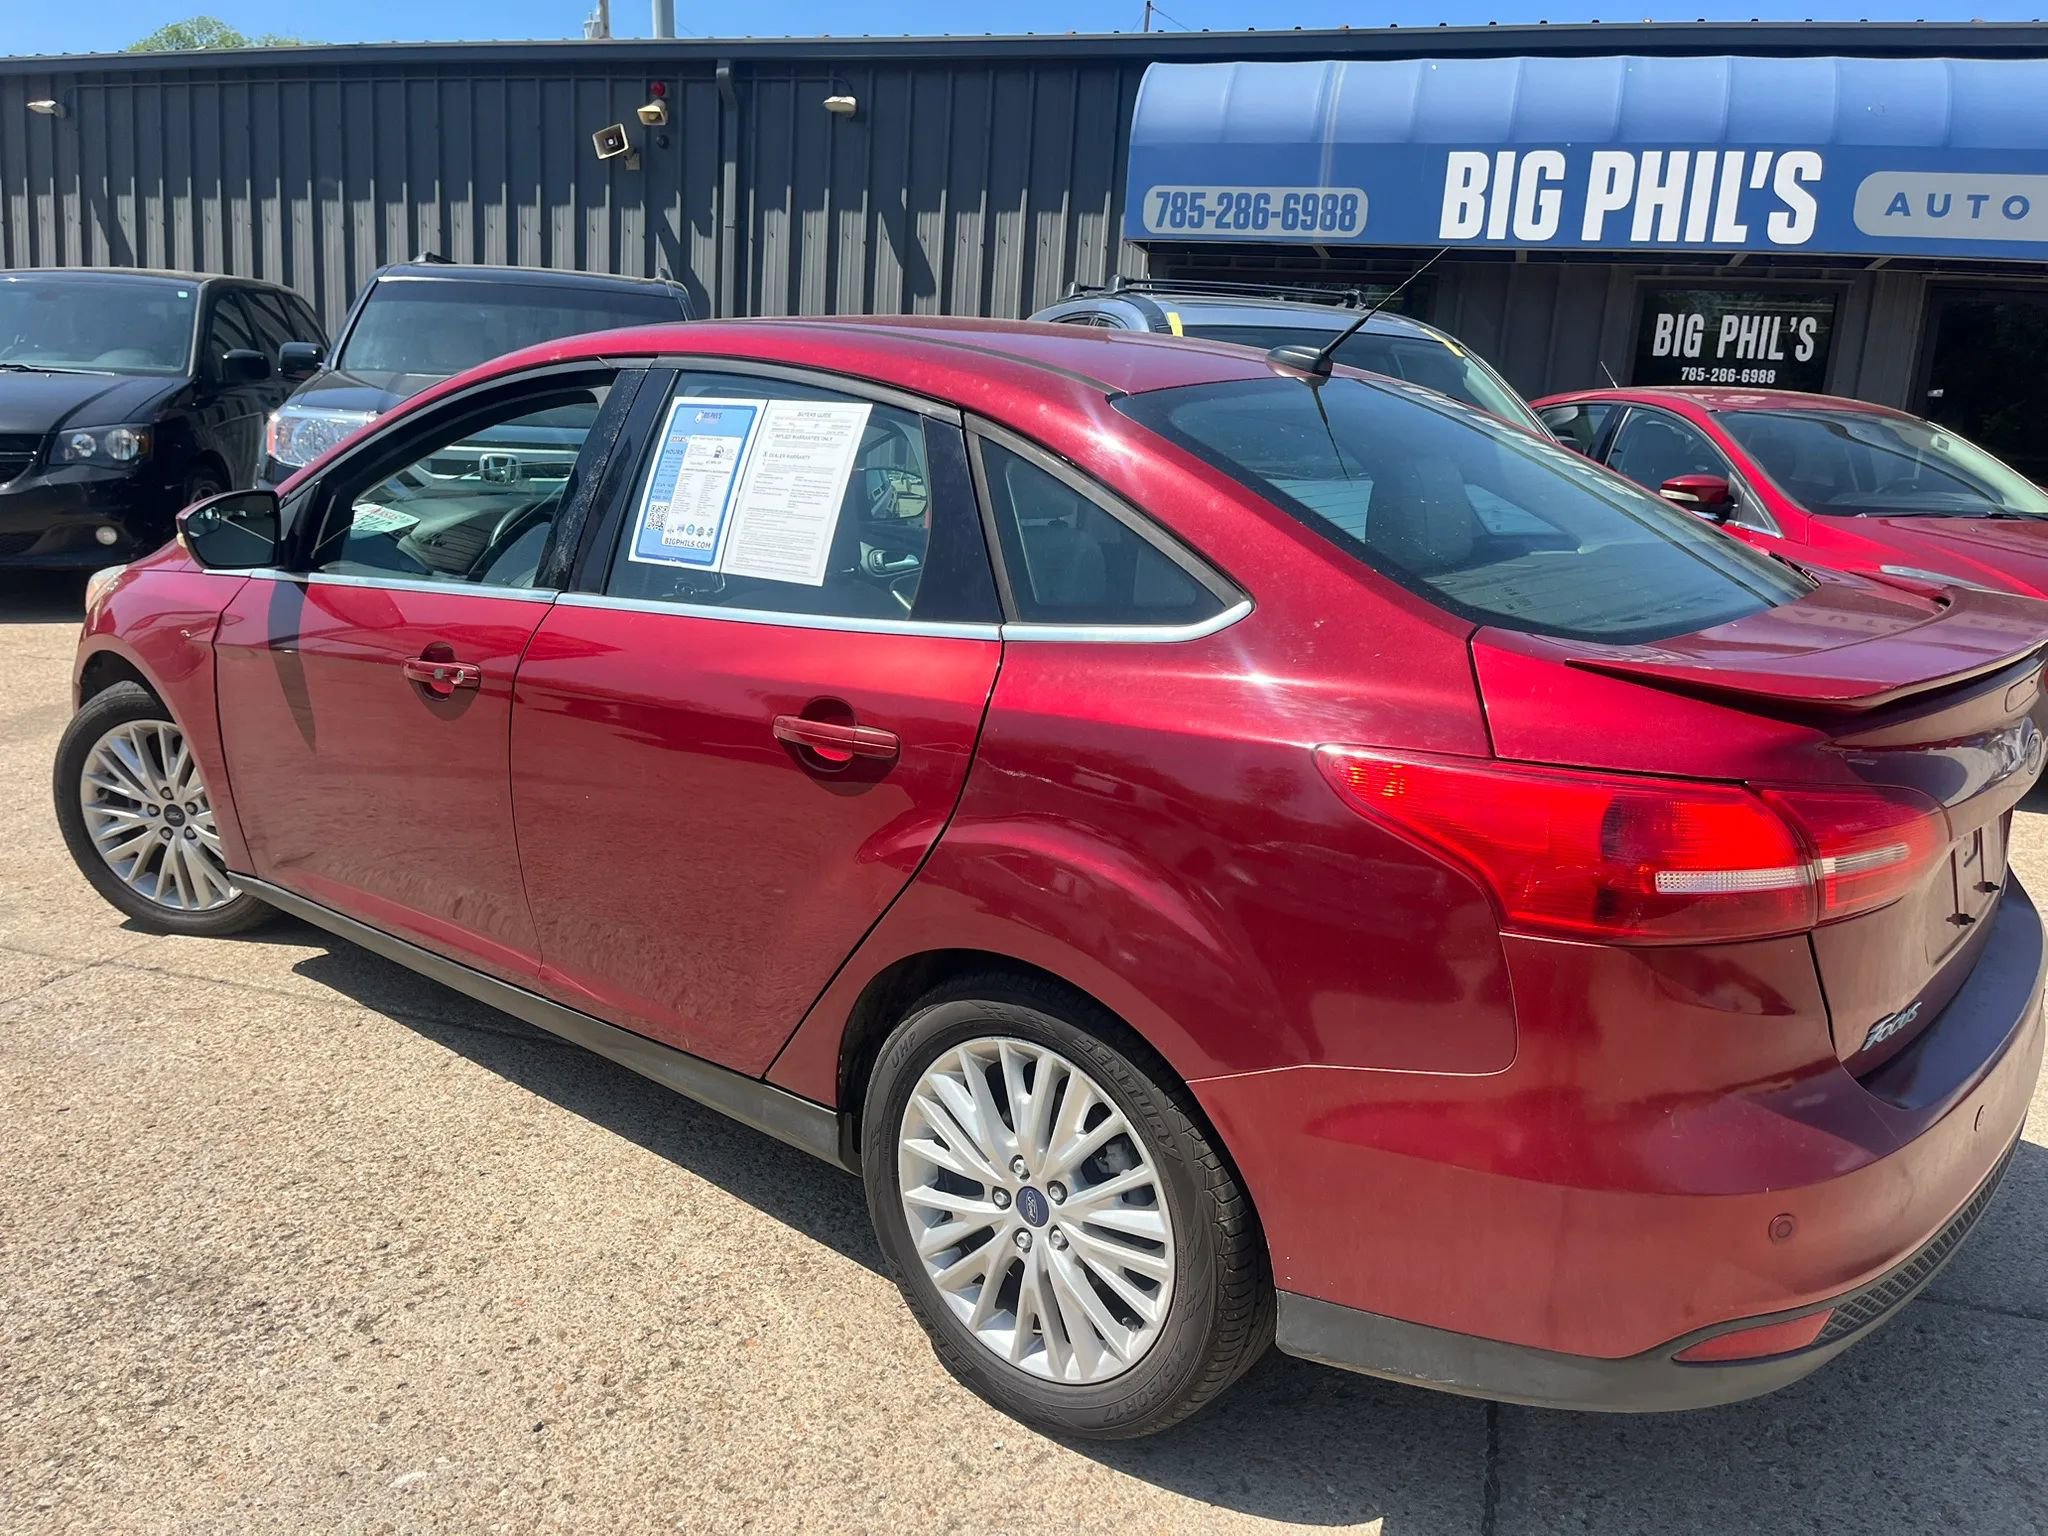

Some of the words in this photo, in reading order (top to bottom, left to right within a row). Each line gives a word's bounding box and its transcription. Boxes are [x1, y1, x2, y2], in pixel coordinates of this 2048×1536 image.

[1155, 191, 1359, 233] 785-286-6988
[1438, 150, 1566, 241] BIG
[1581, 150, 1823, 245] PHIL'S
[1884, 191, 2031, 221] AUTO
[1652, 313, 1705, 358] BIG
[1716, 314, 1817, 362] PHIL'S
[1681, 366, 1776, 384] 785-286-6988
[663, 536, 712, 549] BIGPHILS.COM
[1071, 1034, 1184, 1163] SENTURY
